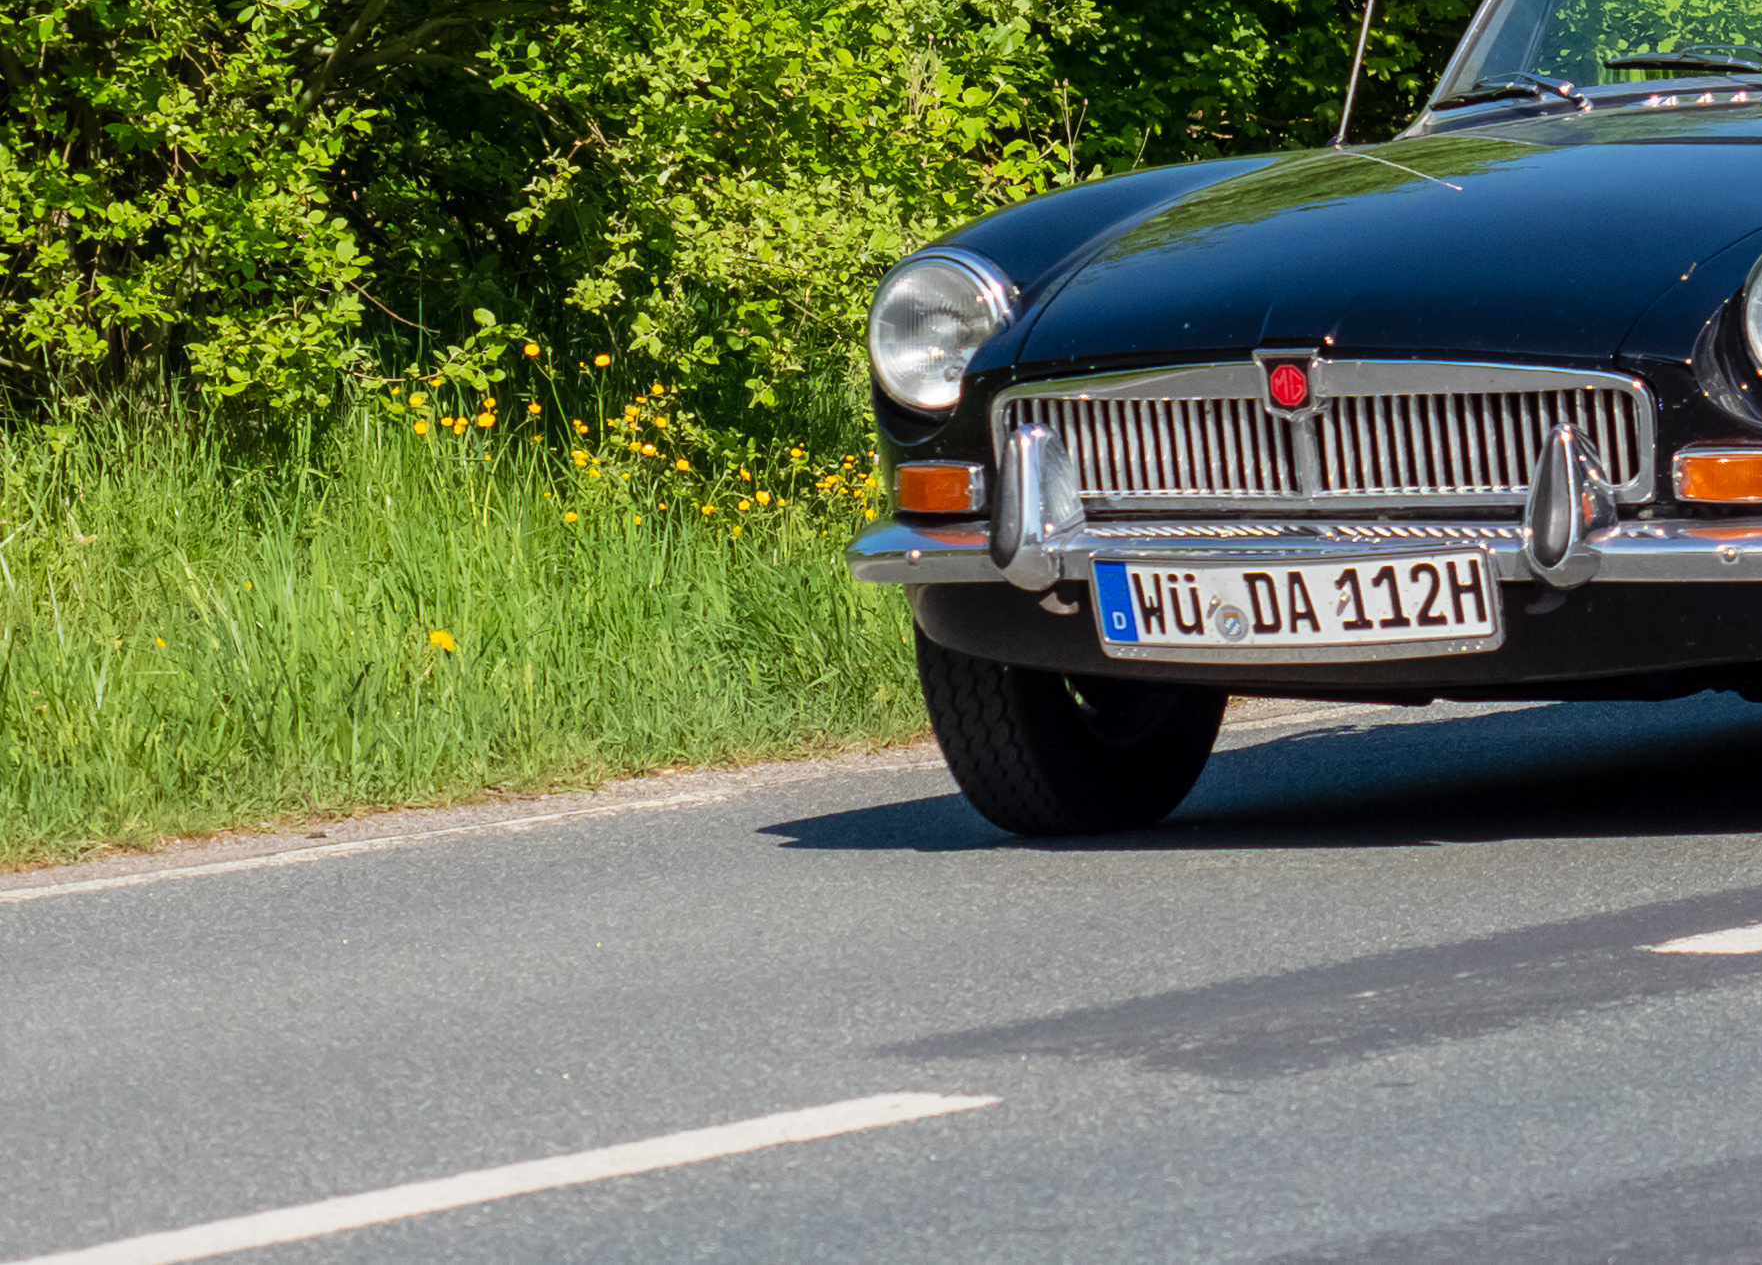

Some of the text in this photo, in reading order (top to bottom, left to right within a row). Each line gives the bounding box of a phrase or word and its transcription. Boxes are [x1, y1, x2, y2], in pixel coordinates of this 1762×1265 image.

[1274, 368, 1304, 401] MG
[1131, 558, 1488, 635] WÜ DA 112H
[1112, 610, 1127, 630] D
